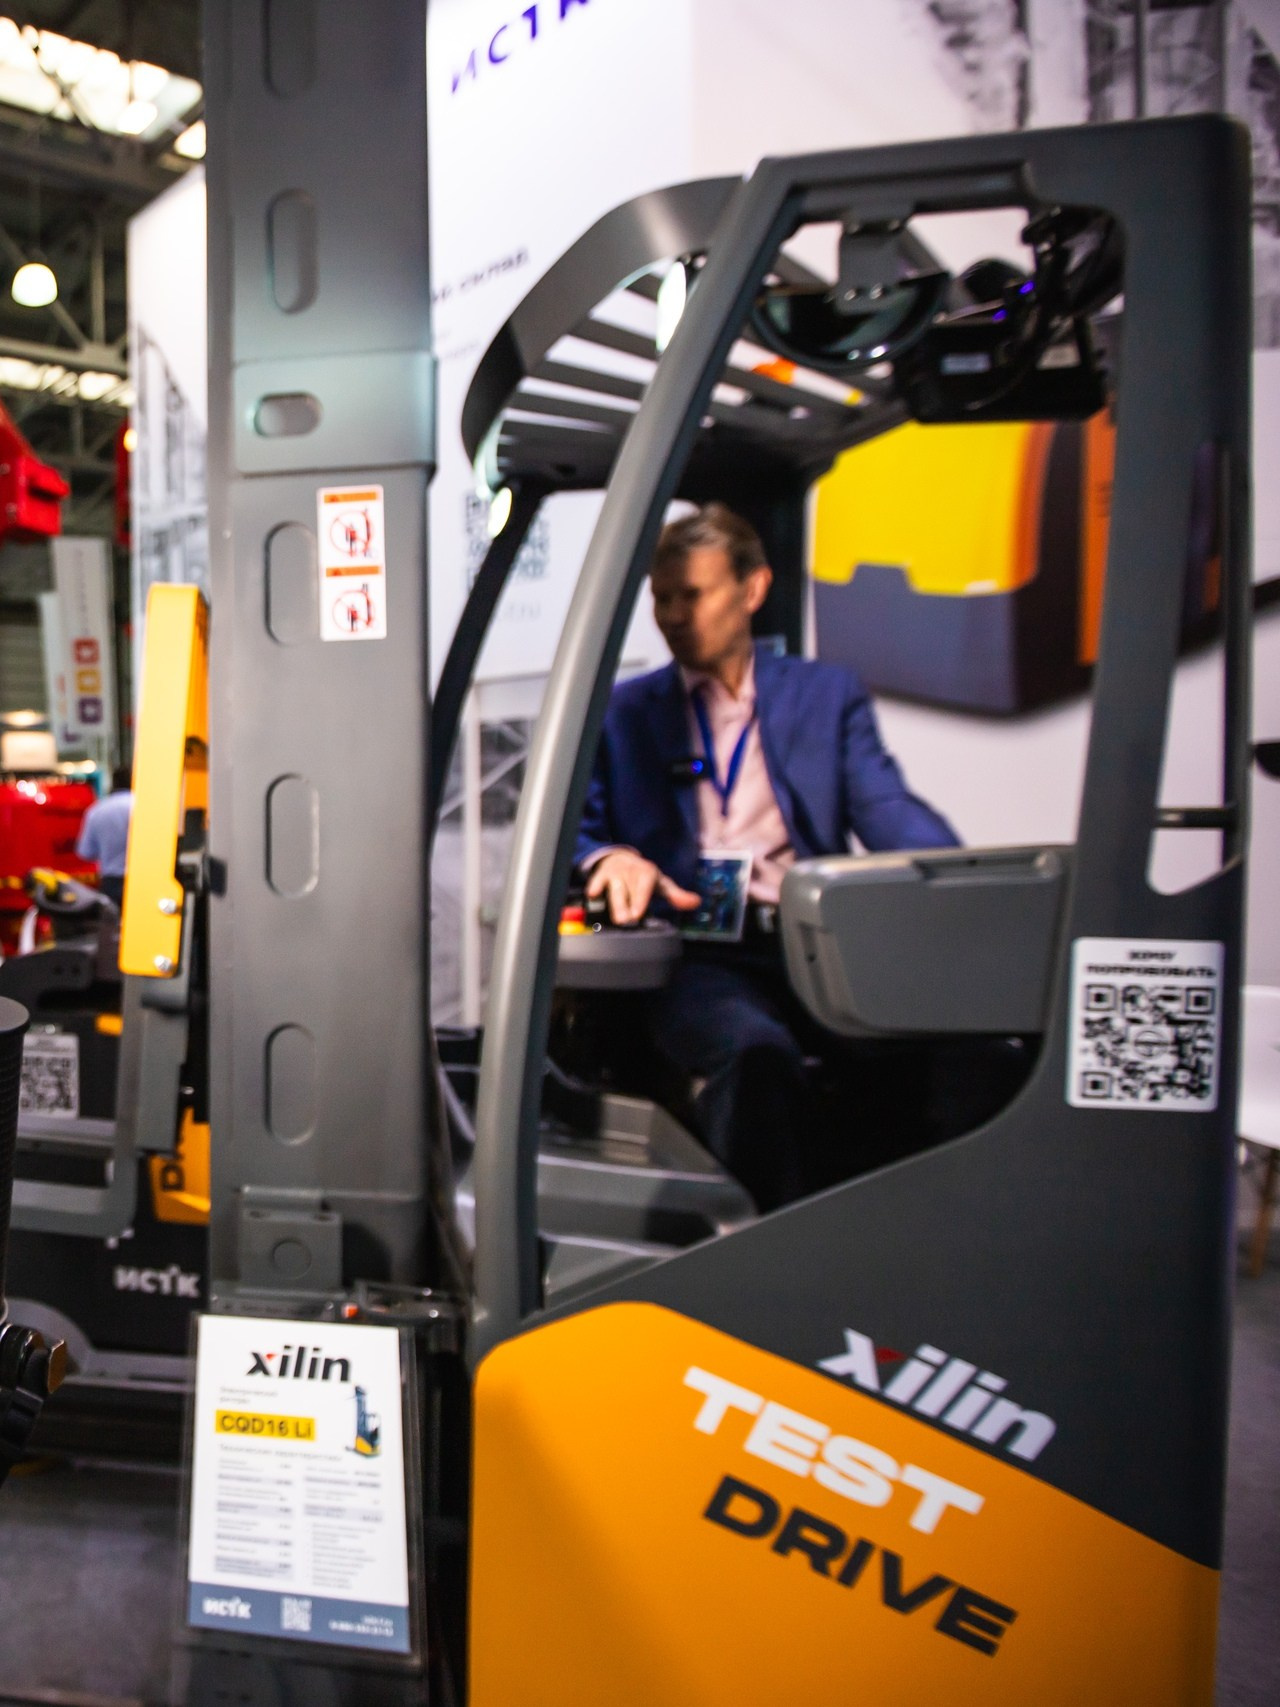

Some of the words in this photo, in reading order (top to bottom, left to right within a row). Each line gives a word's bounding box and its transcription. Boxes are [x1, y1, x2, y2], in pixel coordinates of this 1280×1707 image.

[221, 1415, 289, 1437] CQD16
[246, 1345, 351, 1383] xilin
[815, 1327, 1057, 1462] xilin
[683, 1366, 985, 1535] TEST
[702, 1473, 1018, 1657] DRIVE
